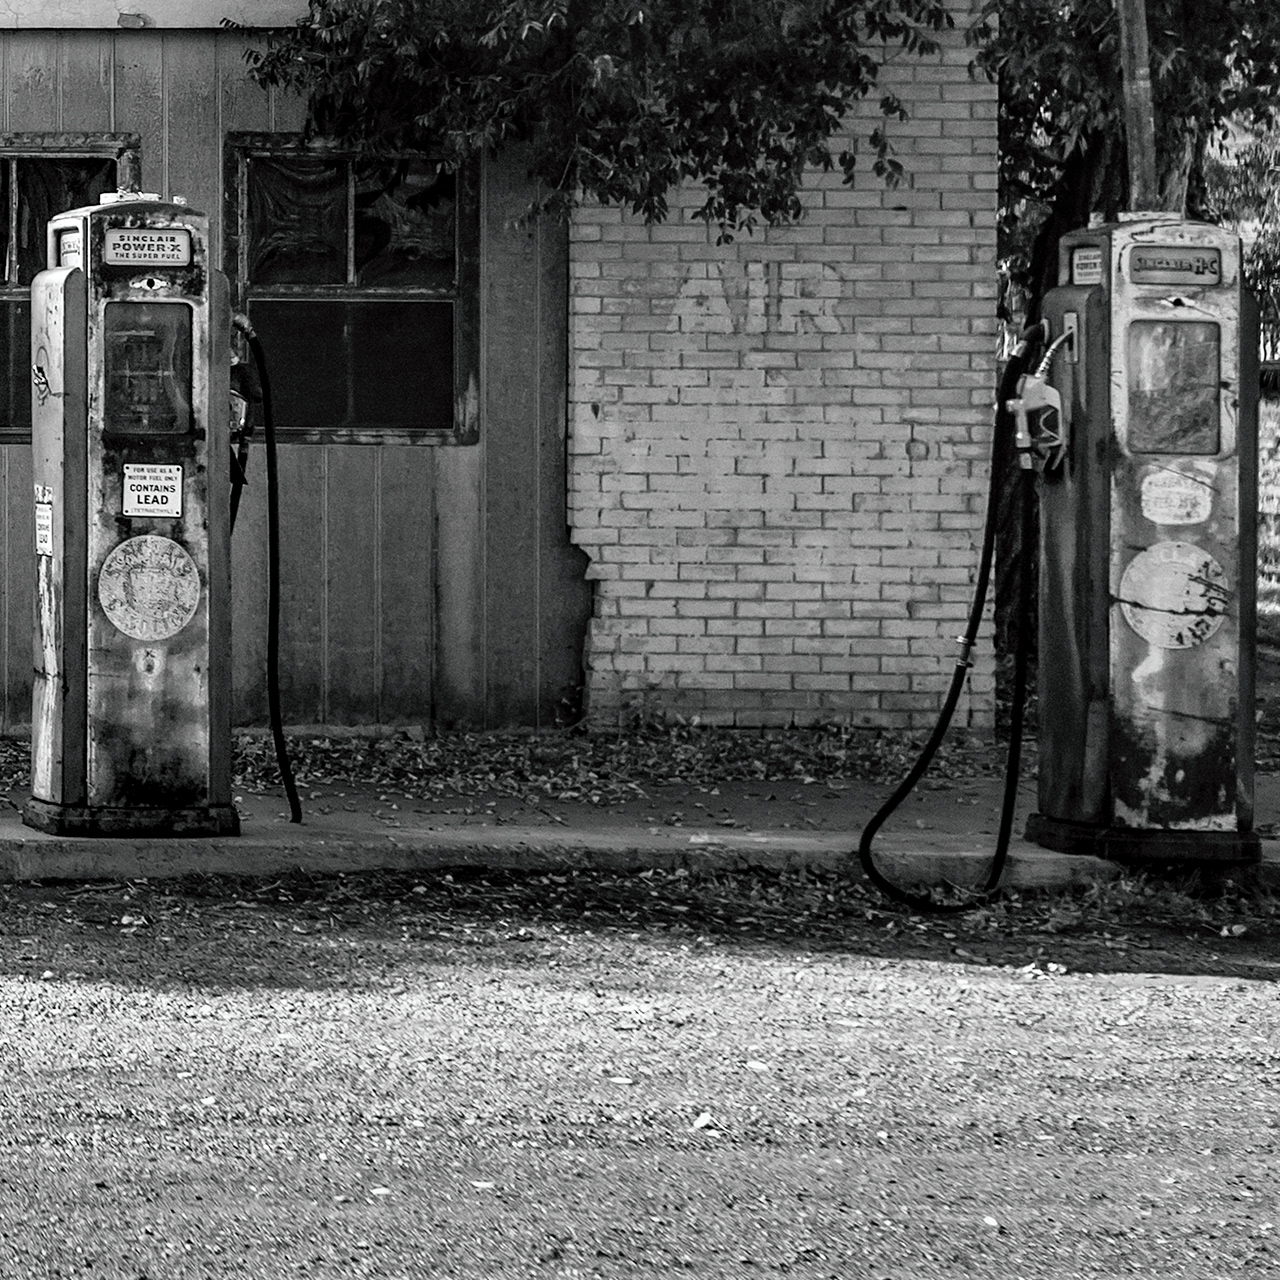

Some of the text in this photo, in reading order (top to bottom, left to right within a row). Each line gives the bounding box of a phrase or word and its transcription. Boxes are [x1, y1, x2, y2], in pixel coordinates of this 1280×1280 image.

[668, 261, 846, 334] AIR
[129, 483, 176, 493] CONTAINS
[137, 494, 169, 505] LEAD
